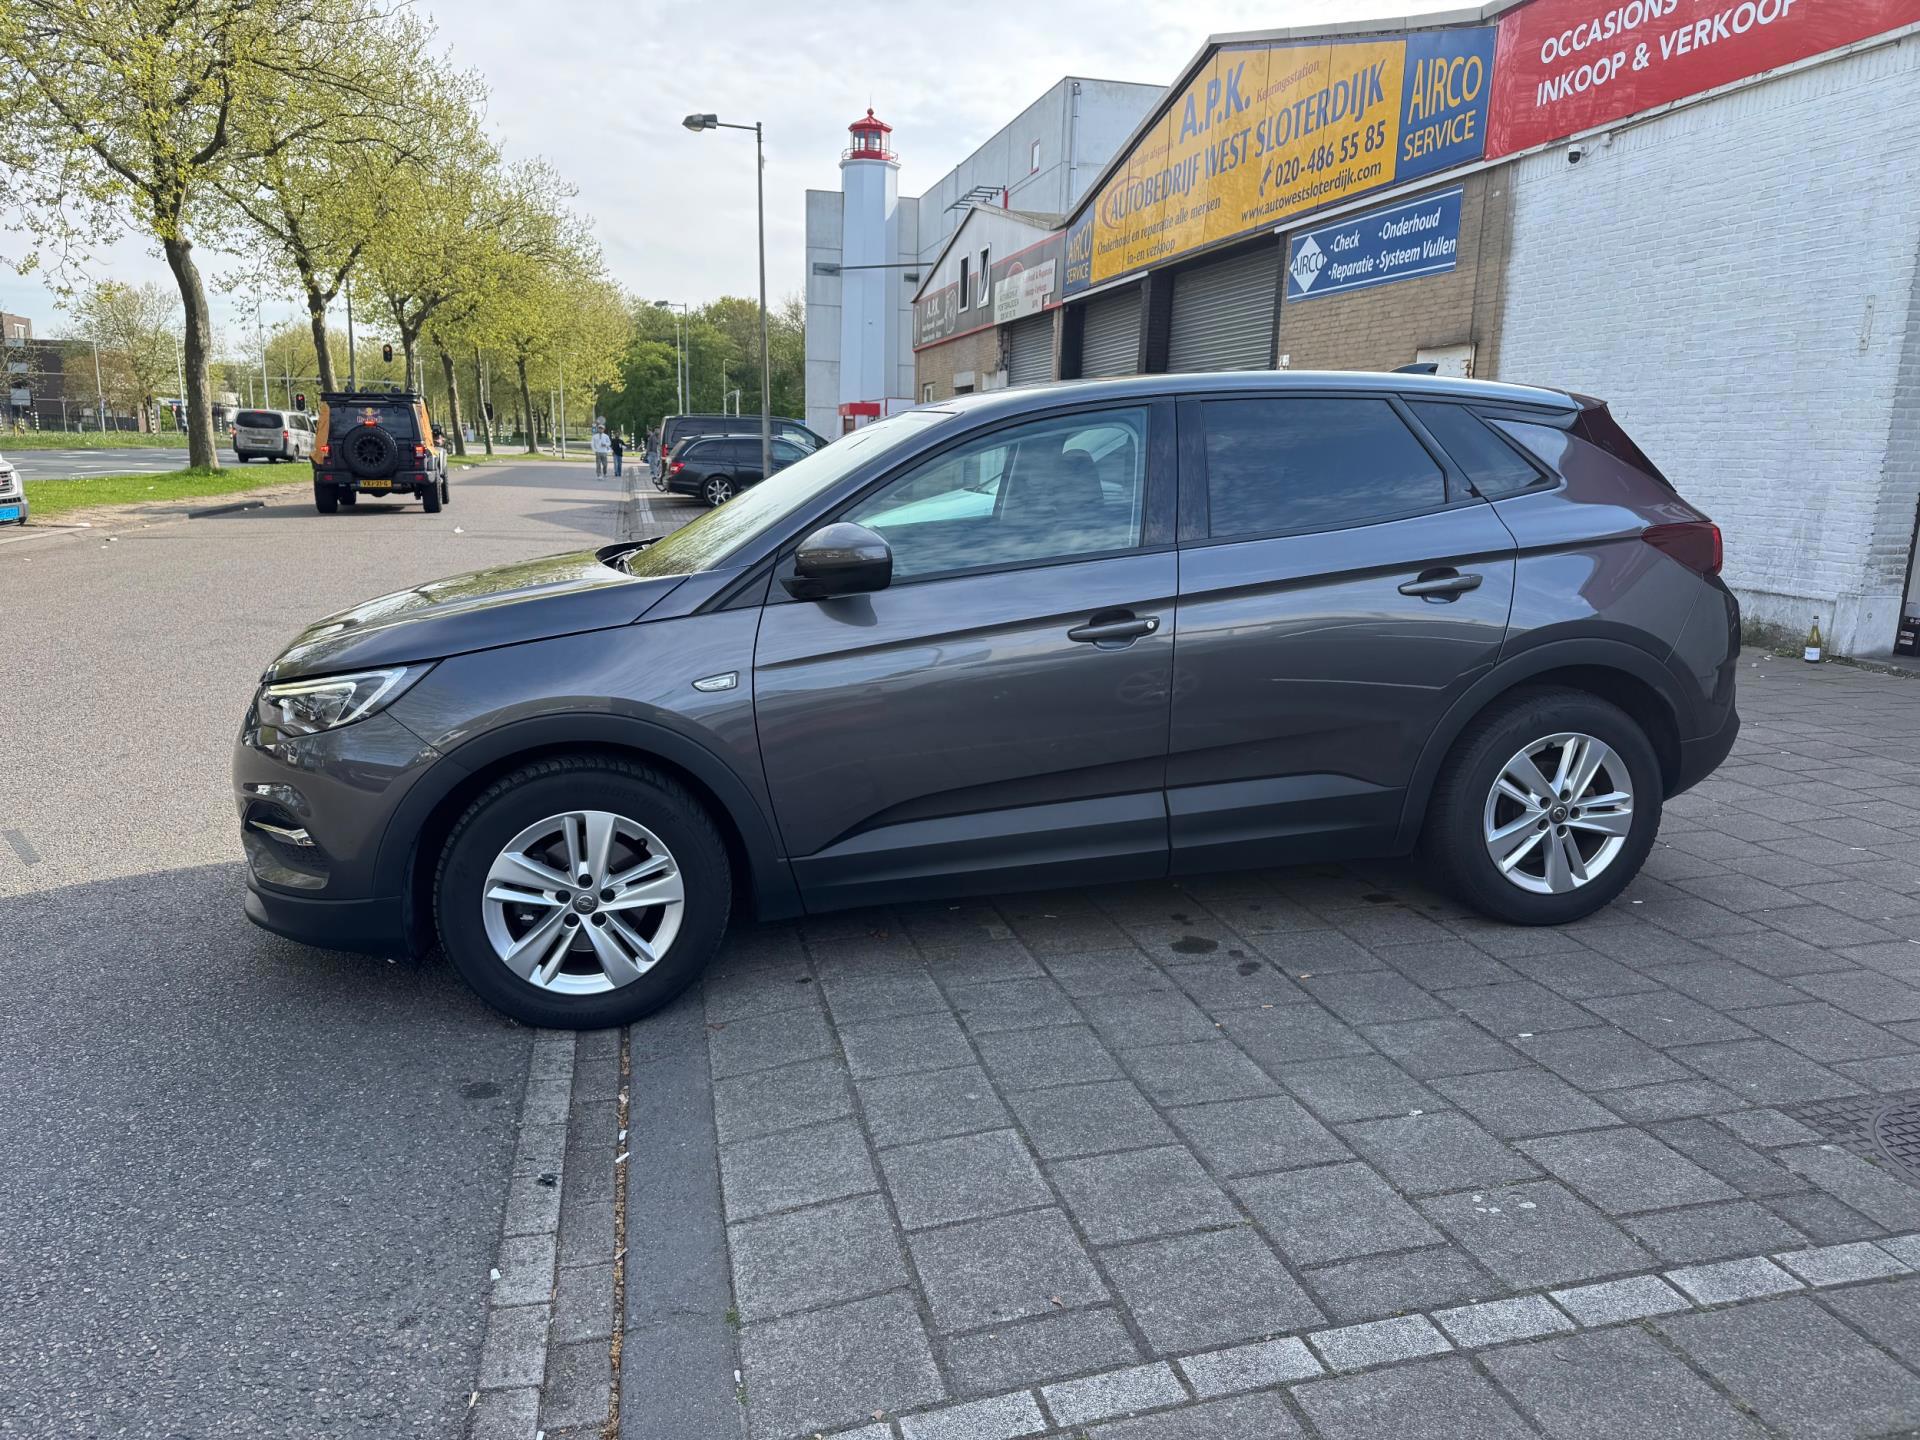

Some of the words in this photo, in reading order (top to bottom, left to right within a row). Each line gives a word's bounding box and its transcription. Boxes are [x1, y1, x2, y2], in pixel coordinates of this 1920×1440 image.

[1179, 60, 1251, 145] A.P.K.
[1256, 59, 1320, 104] Keuringsstation
[1407, 55, 1483, 125] AIRCO
[1536, 51, 1626, 107] INKOOP
[1632, 42, 1651, 71] &
[1109, 151, 1201, 221] AUTOBEDRIJF
[1204, 127, 1252, 181] WEST
[1254, 58, 1387, 159] SLOTERDIJK
[1274, 141, 1335, 189] 020-486
[1338, 131, 1360, 165] 55
[1364, 119, 1386, 154] 85
[1403, 109, 1477, 161] SERVICE
[1240, 161, 1382, 223] www.autowestsloterdijk.com
[1068, 220, 1092, 265] AIRCO
[1097, 231, 1131, 256] Onderhoud
[1131, 229, 1140, 242] en
[1140, 215, 1174, 241] reparatie
[1174, 206, 1189, 225] alle
[1190, 196, 1221, 219] merken
[1145, 238, 1176, 260] verkoop
[1333, 229, 1361, 253] Check
[1382, 206, 1442, 240] Onderhoud
[1066, 262, 1089, 285] SERVICE
[1292, 250, 1325, 277] AIRCO
[1330, 254, 1374, 282] Reparatie
[1379, 244, 1421, 272] Systeem
[1422, 235, 1457, 260] Vullen
